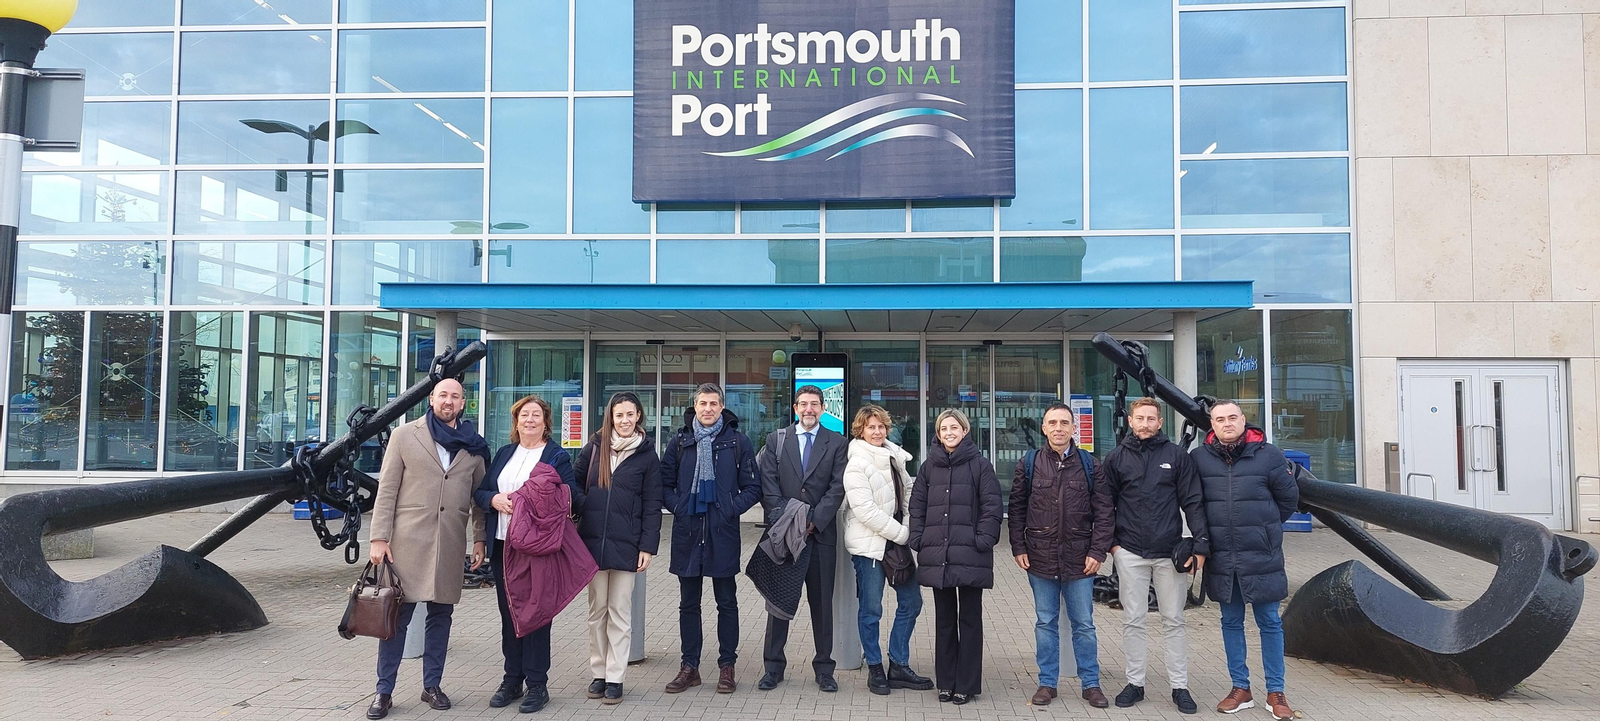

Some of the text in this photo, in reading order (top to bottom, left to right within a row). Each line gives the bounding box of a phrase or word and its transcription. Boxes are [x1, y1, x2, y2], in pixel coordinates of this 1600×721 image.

[671, 18, 961, 67] Portsmouth
[671, 65, 961, 90] INTERNATIONAL
[671, 93, 771, 136] Port
